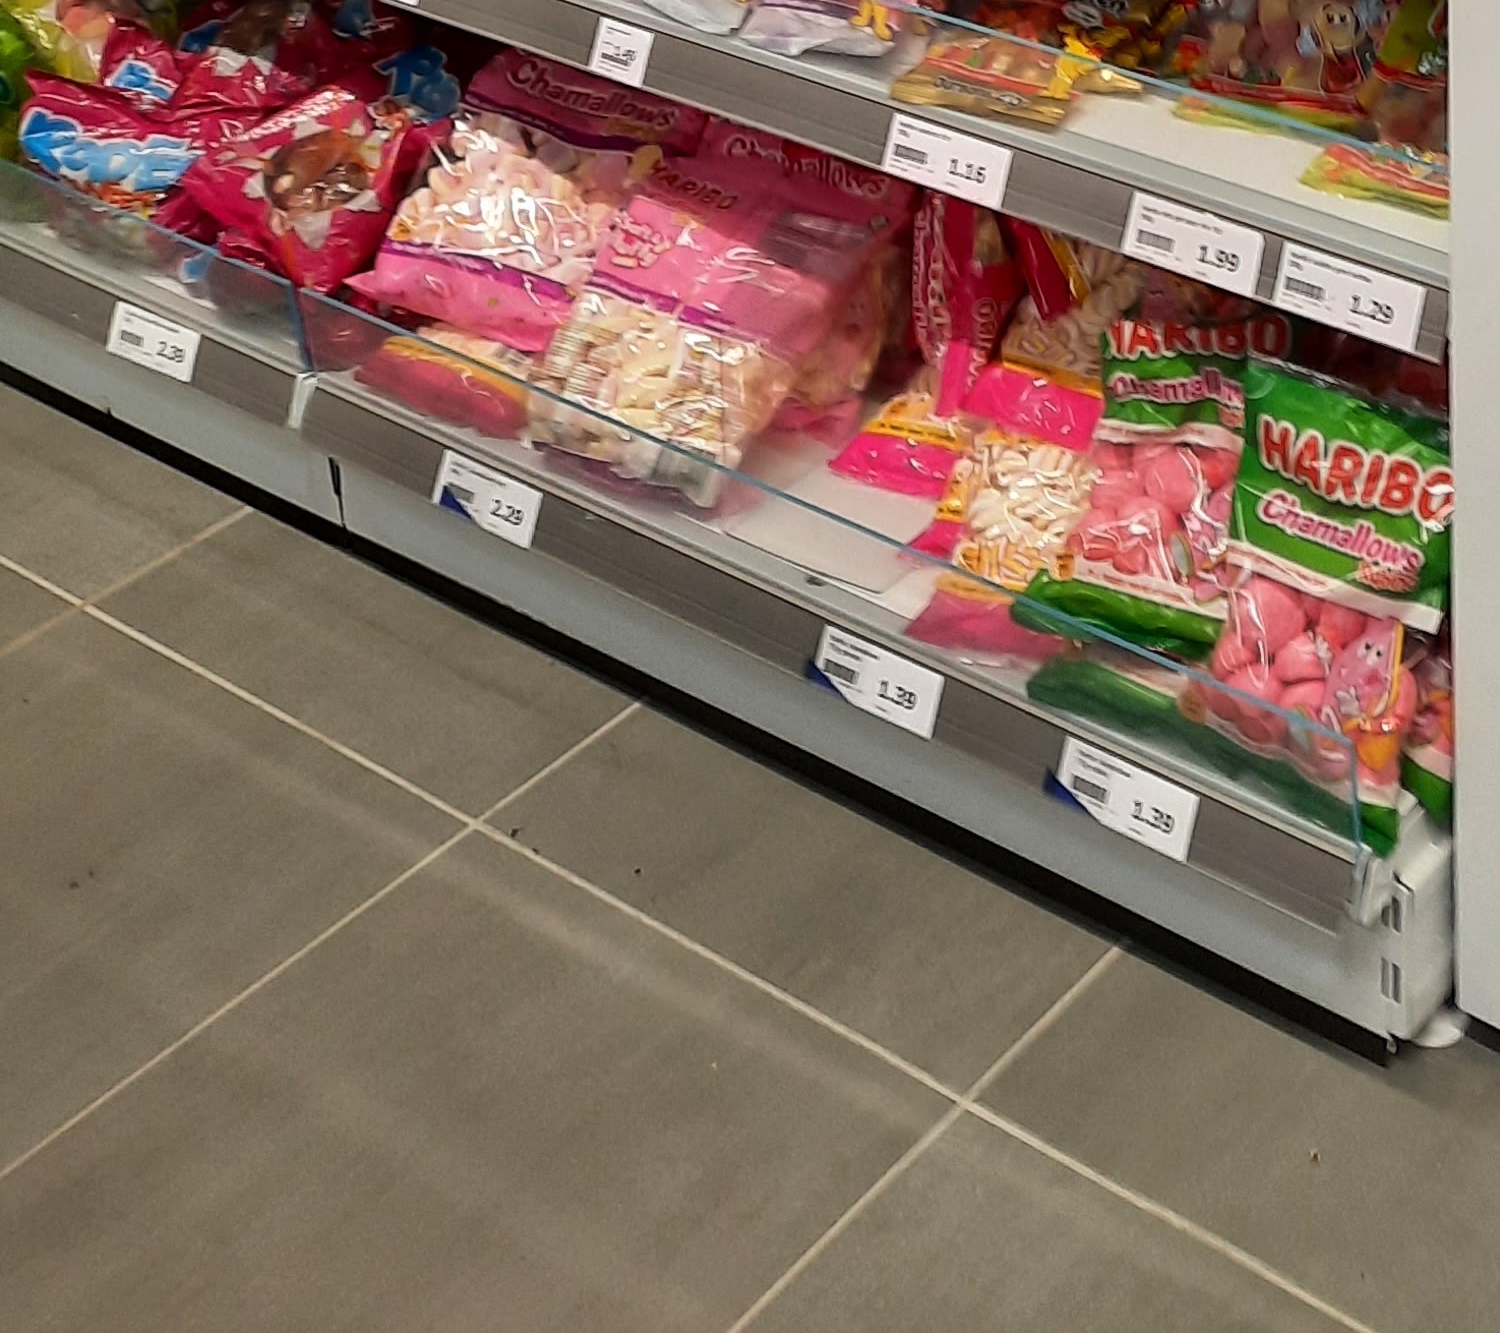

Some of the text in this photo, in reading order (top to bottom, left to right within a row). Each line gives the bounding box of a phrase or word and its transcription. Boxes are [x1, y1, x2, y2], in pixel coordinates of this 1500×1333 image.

[507, 57, 680, 129] Chamallows
[1256, 414, 1455, 529] HARIBO
[1260, 489, 1426, 575] Chamallows
